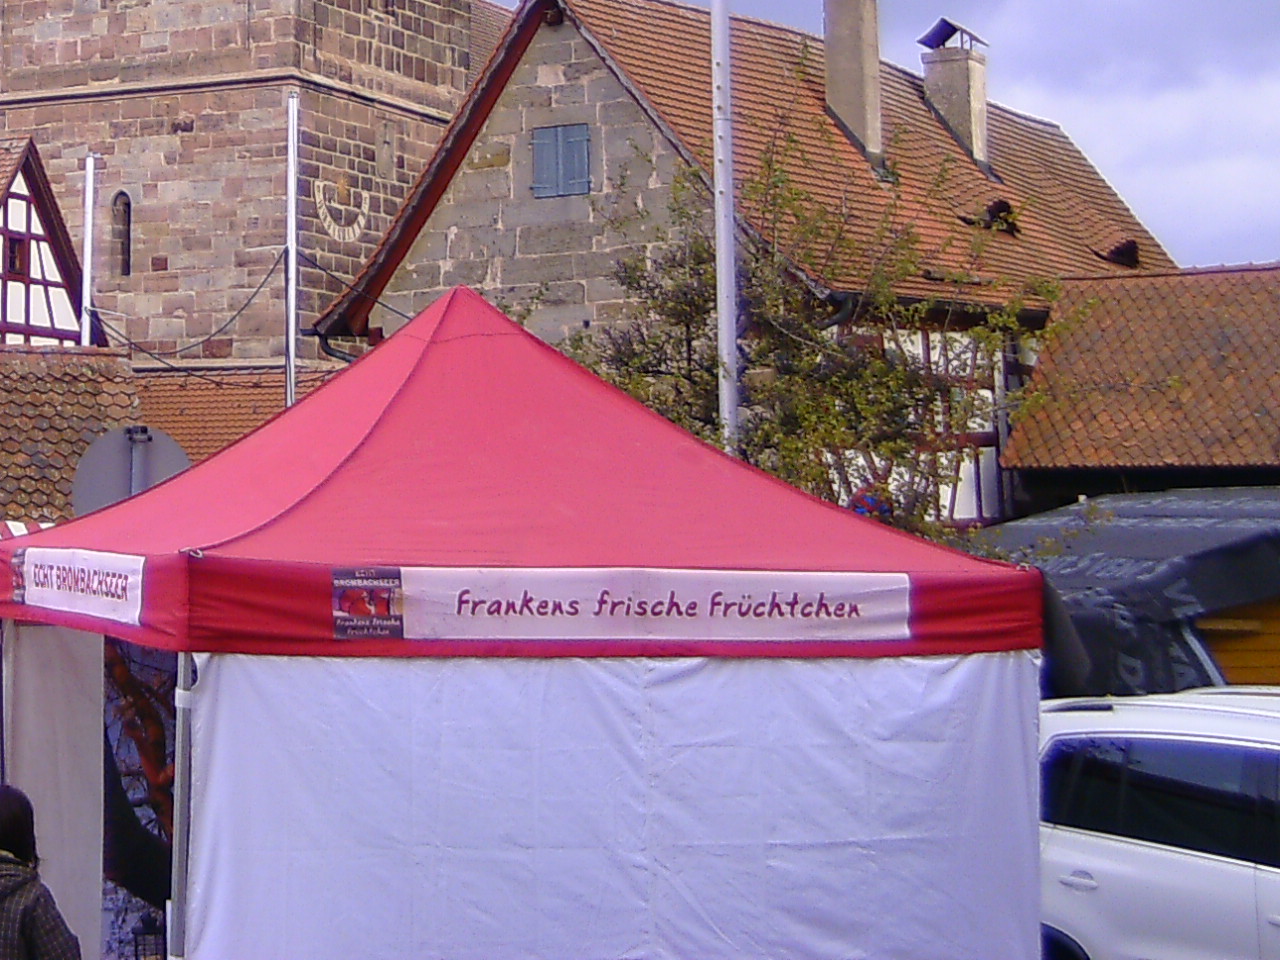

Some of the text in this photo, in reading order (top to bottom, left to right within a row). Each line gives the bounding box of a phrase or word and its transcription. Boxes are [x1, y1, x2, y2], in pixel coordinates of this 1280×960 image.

[33, 563, 55, 590] ECHT
[55, 565, 129, 601] BROMBACHSEER
[456, 589, 862, 618] Frankens frische Früchtchen
